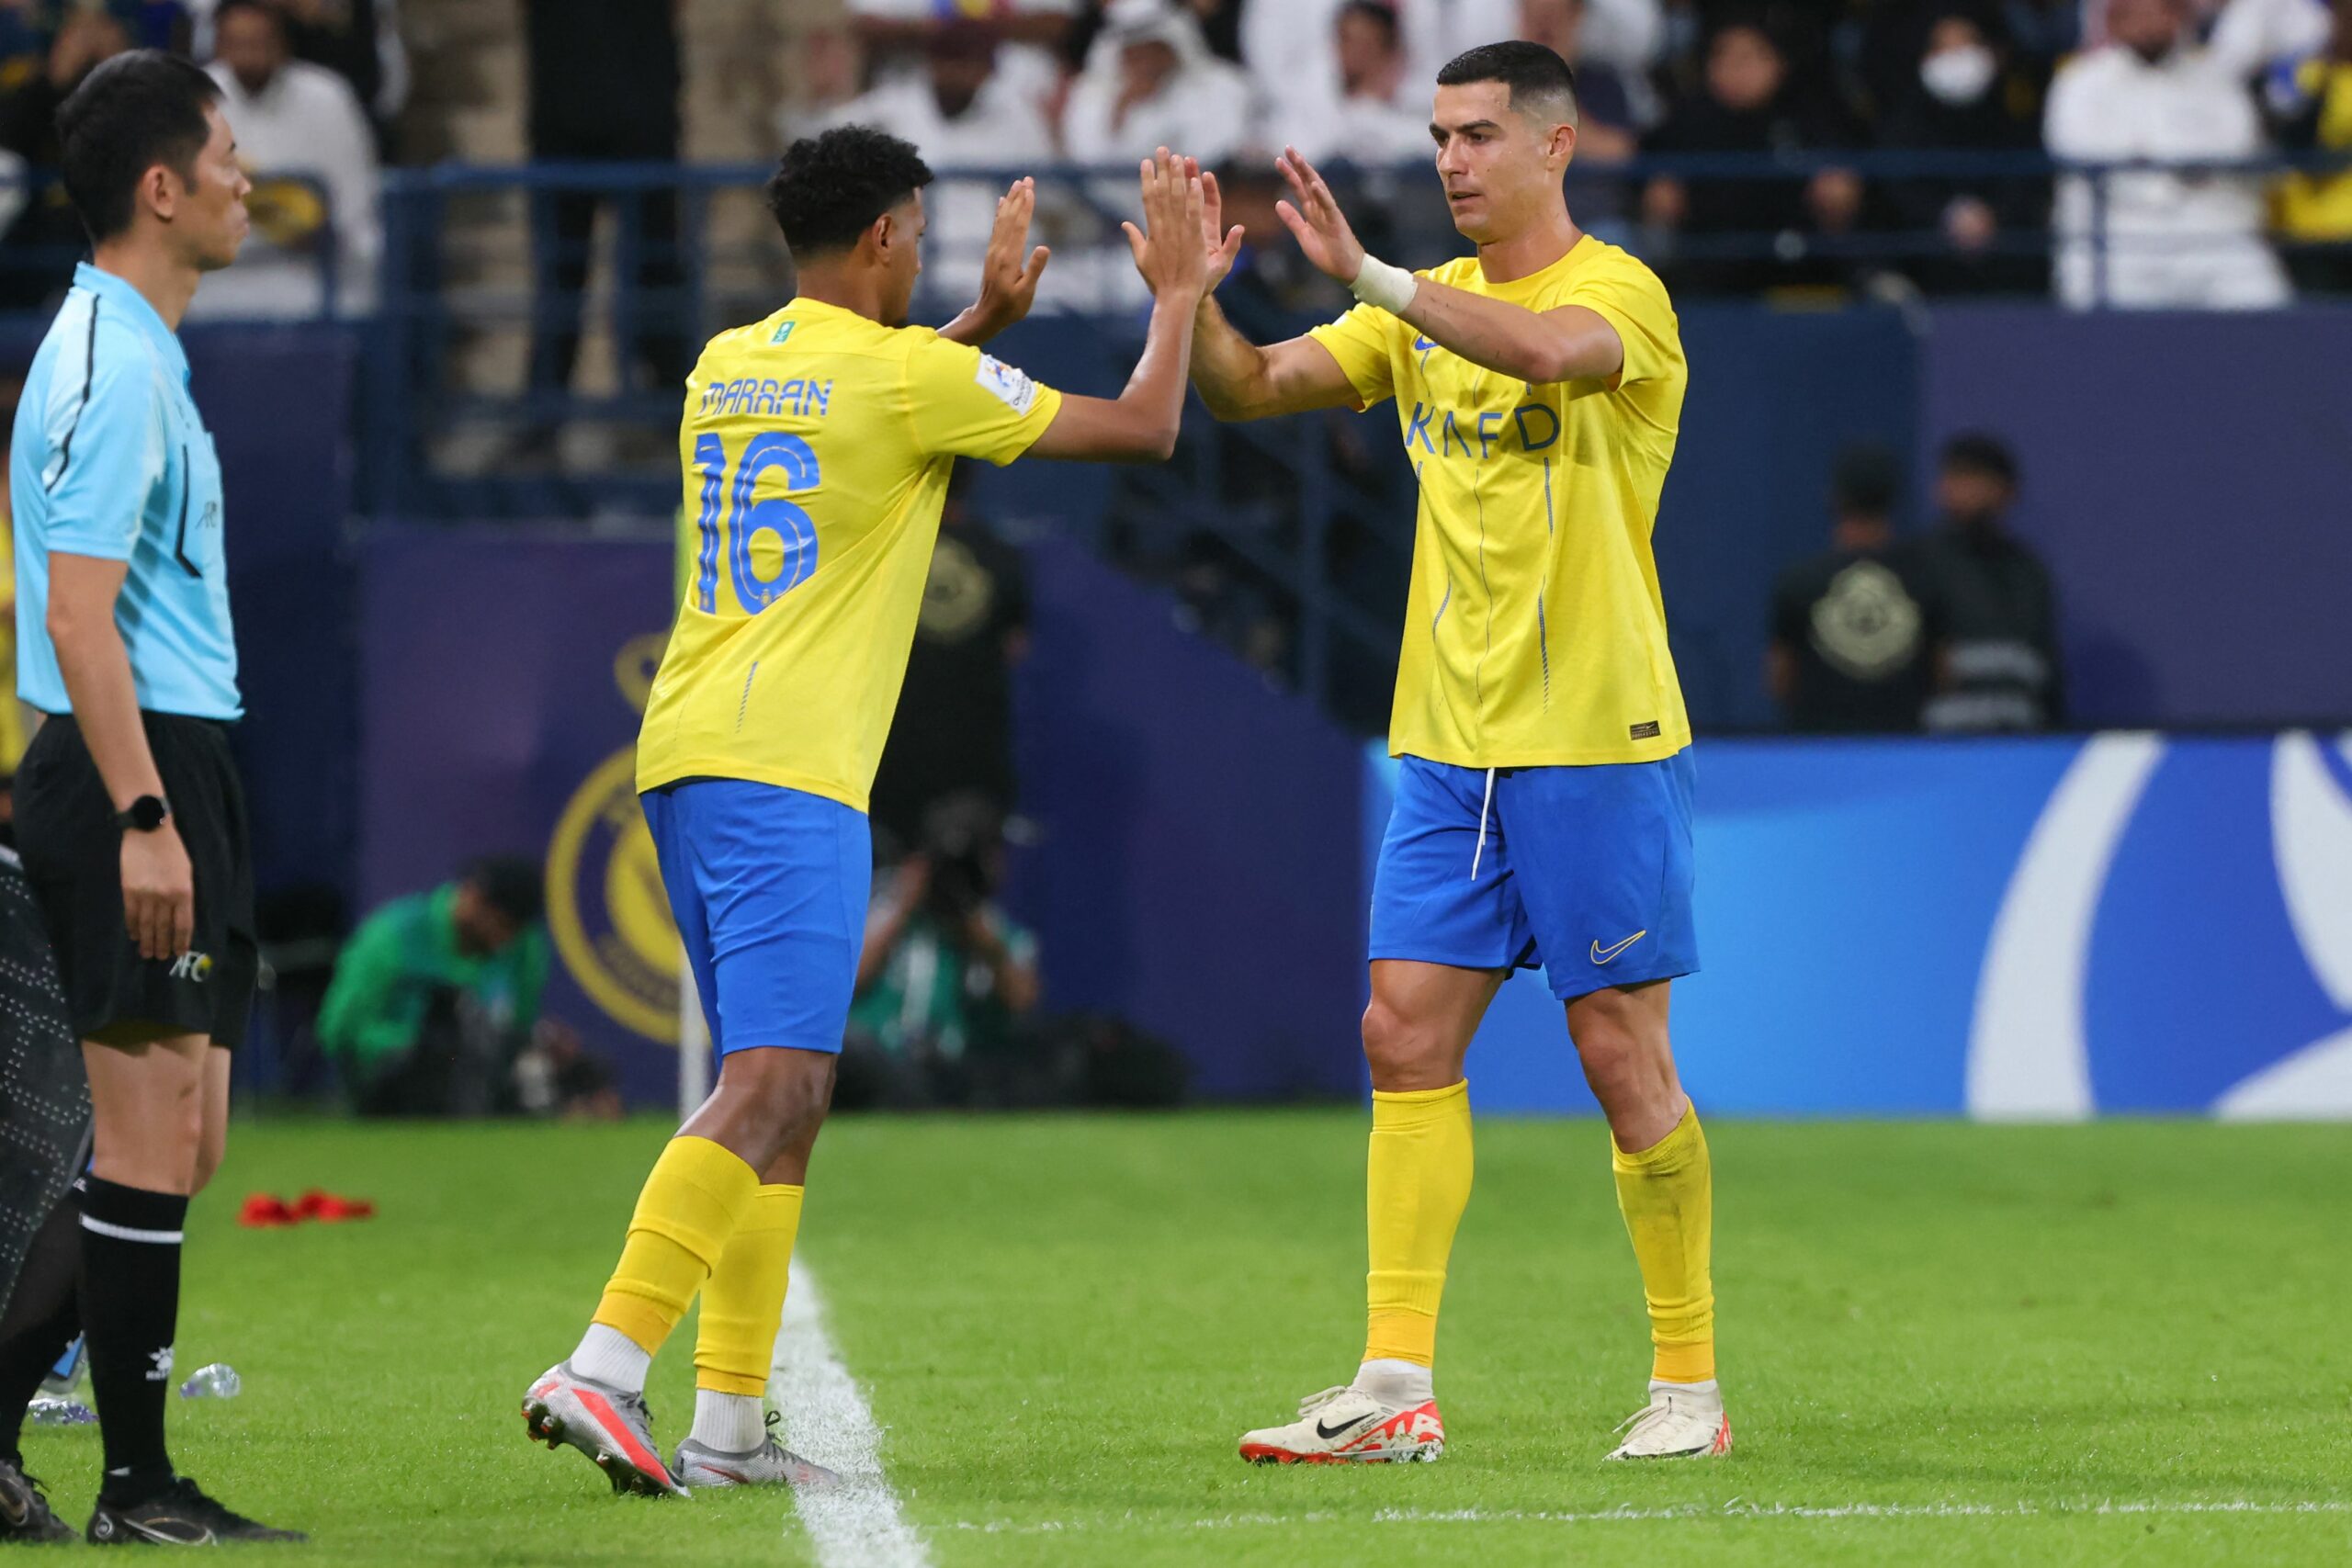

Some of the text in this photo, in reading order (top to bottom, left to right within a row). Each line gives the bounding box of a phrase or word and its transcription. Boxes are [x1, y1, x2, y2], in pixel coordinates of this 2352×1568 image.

[697, 378, 833, 416] MARRAN
[1405, 401, 1560, 459] KAFD
[693, 431, 820, 615] 16
